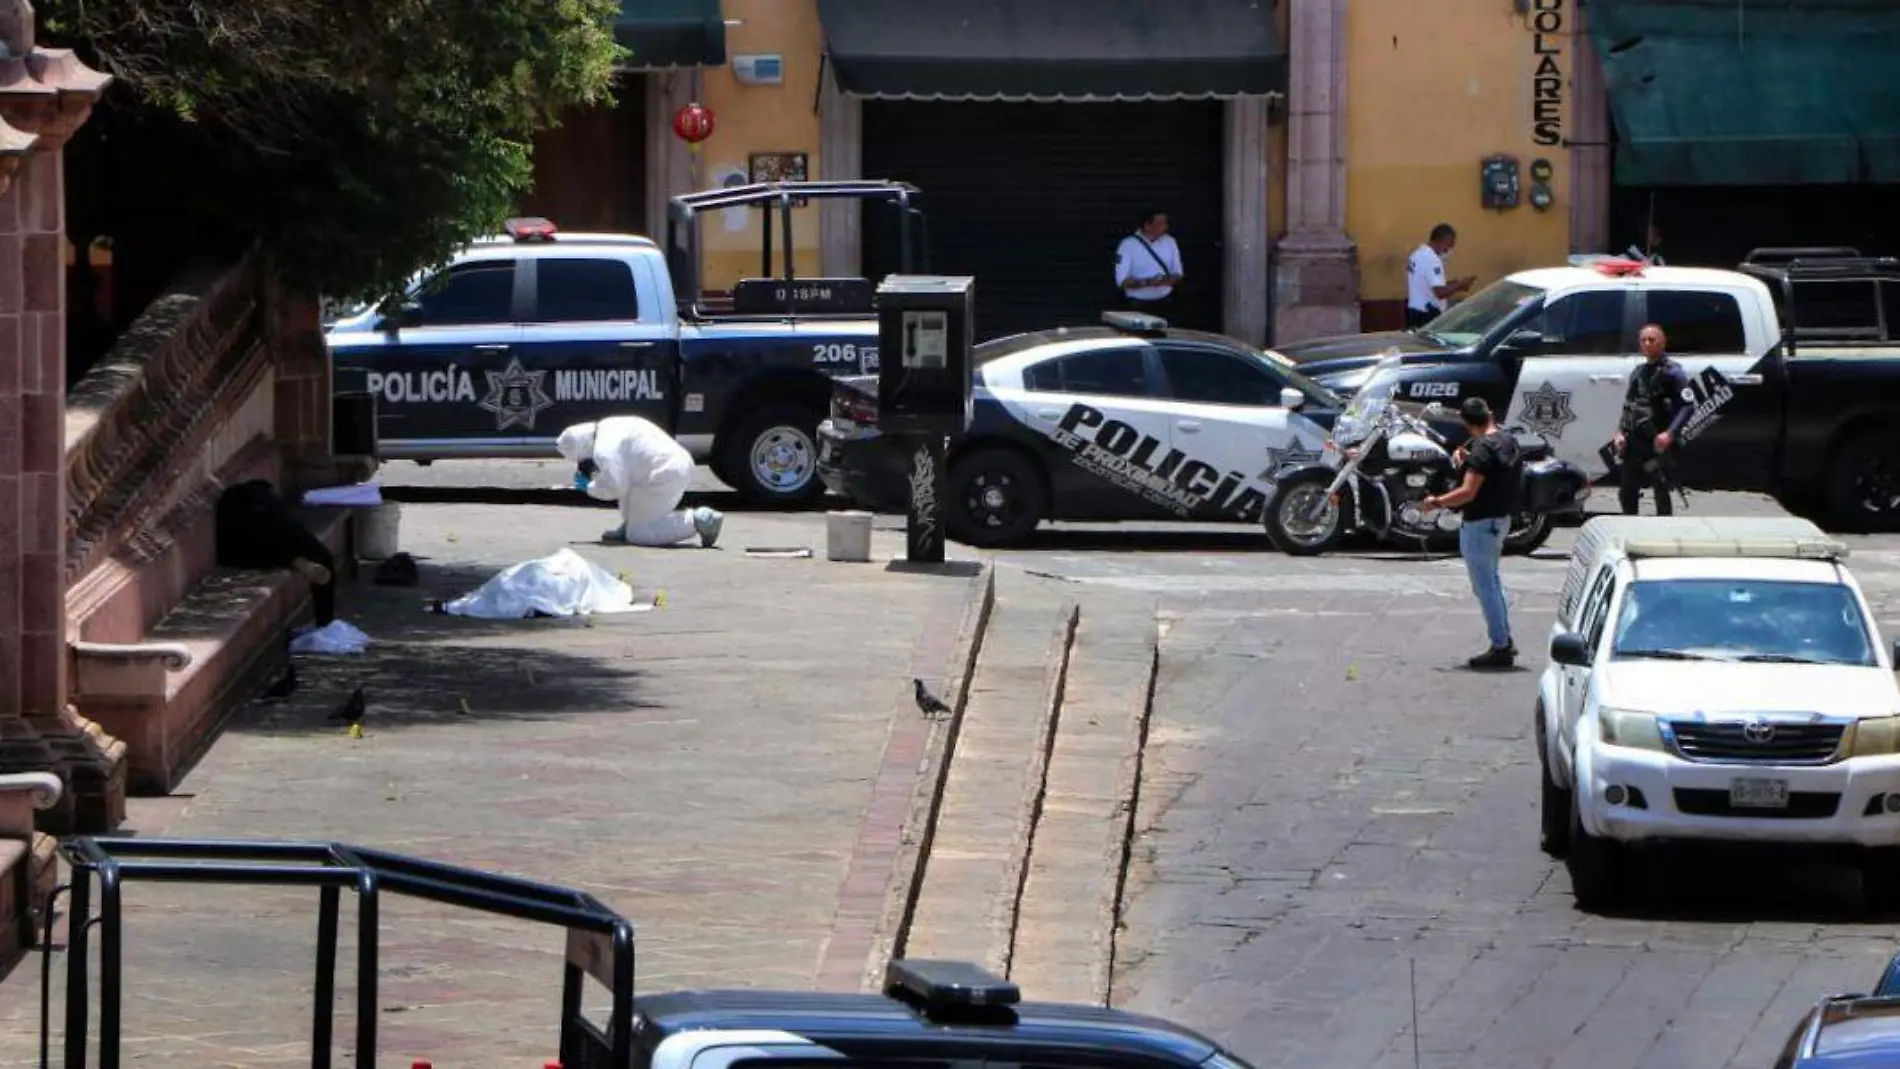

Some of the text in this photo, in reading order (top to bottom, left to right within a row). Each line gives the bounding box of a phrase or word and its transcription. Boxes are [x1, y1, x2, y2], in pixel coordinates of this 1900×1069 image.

[812, 345, 856, 362] 206
[367, 364, 662, 402] POLICÍA MUNICIPAL
[1409, 382, 1460, 397] 0126
[1049, 428, 1080, 451] DE
[1057, 402, 1266, 523] POLICÍA
